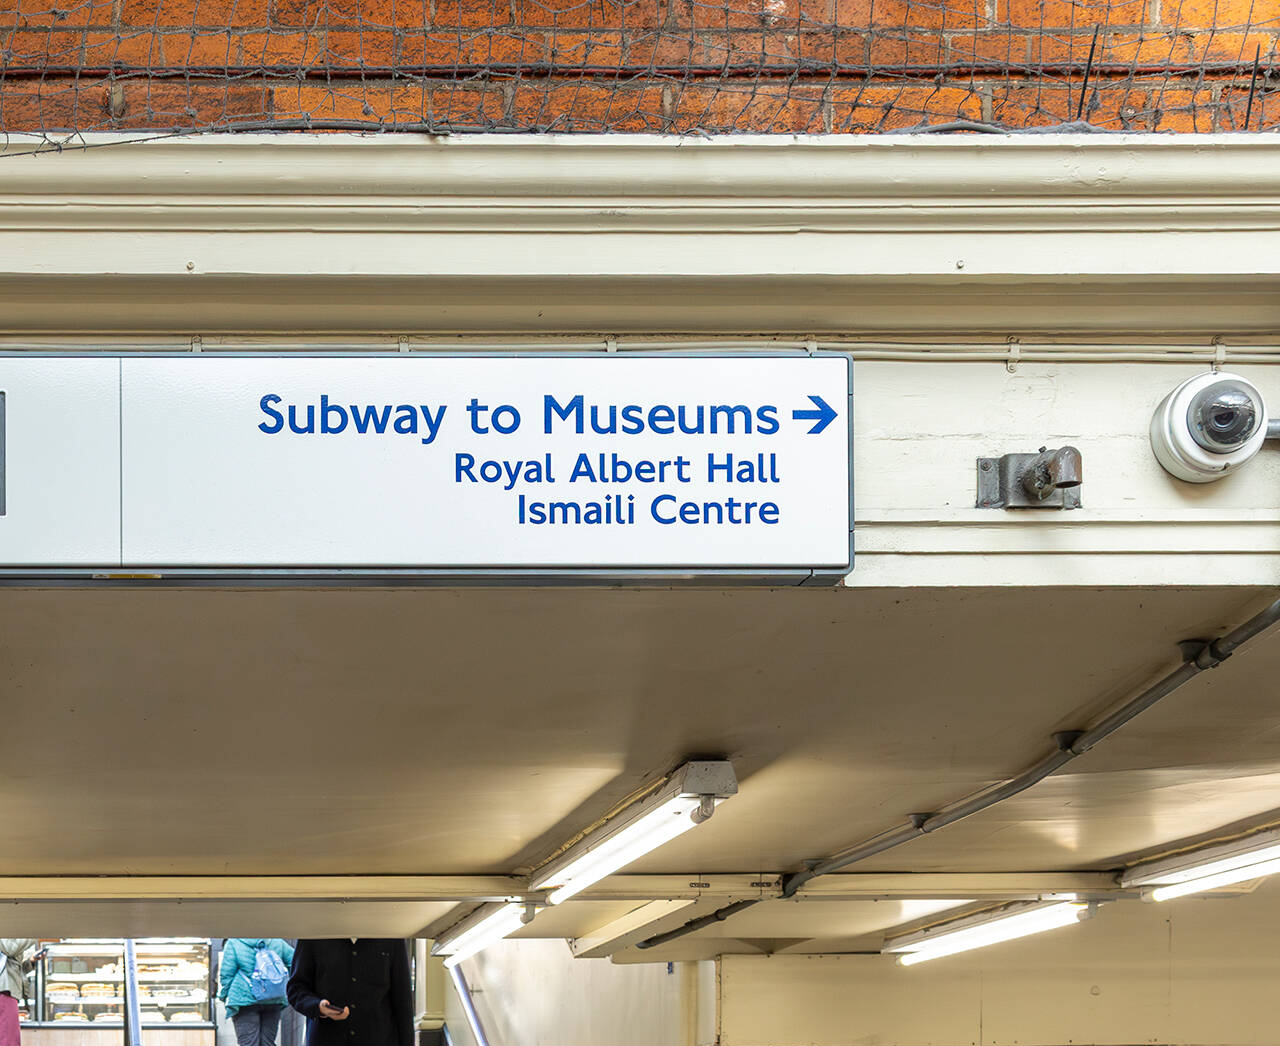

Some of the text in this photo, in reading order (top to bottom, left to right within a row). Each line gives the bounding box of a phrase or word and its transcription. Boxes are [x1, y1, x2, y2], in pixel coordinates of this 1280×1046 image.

[257, 394, 780, 444] Subway to Museums
[454, 452, 780, 490] Royal Albert Hall
[519, 494, 780, 525] Ismaili Centre
